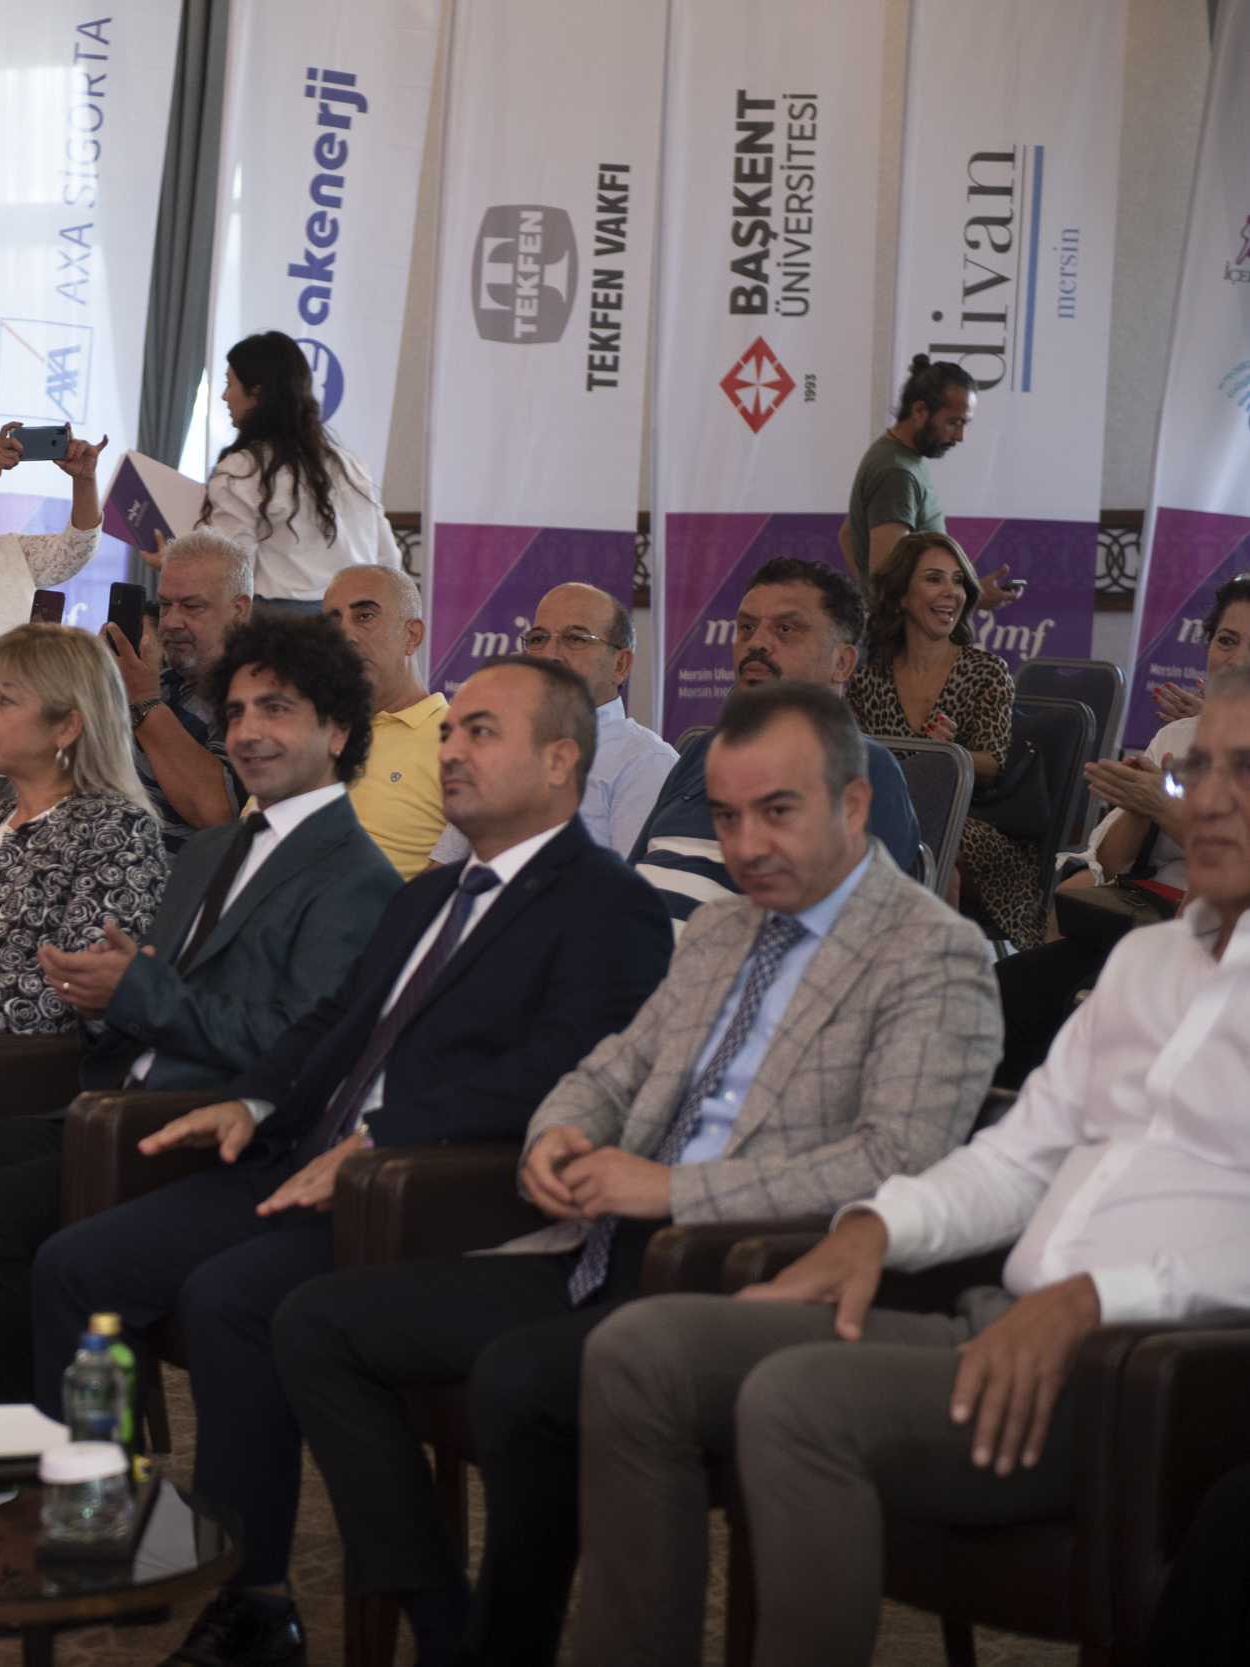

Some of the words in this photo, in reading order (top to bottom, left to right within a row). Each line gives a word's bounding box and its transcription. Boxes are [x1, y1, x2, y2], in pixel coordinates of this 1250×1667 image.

[57, 16, 113, 209] SİGORTA
[288, 66, 368, 326] akenerji
[593, 163, 631, 257] VAKFI
[729, 89, 779, 315] BAŞKENT
[774, 94, 818, 317] ÜNİVERSİTESİ
[55, 222, 95, 306] AXA
[513, 210, 544, 339] TEKFEN
[928, 144, 1017, 392] divan
[1052, 227, 1080, 319] mersin
[1224, 260, 1250, 284] İÇE
[586, 268, 624, 392] TEKFEN
[804, 373, 816, 403] 1993
[678, 668, 712, 681] Mersin
[714, 667, 736, 681] Ulus
[972, 609, 1056, 662] imf
